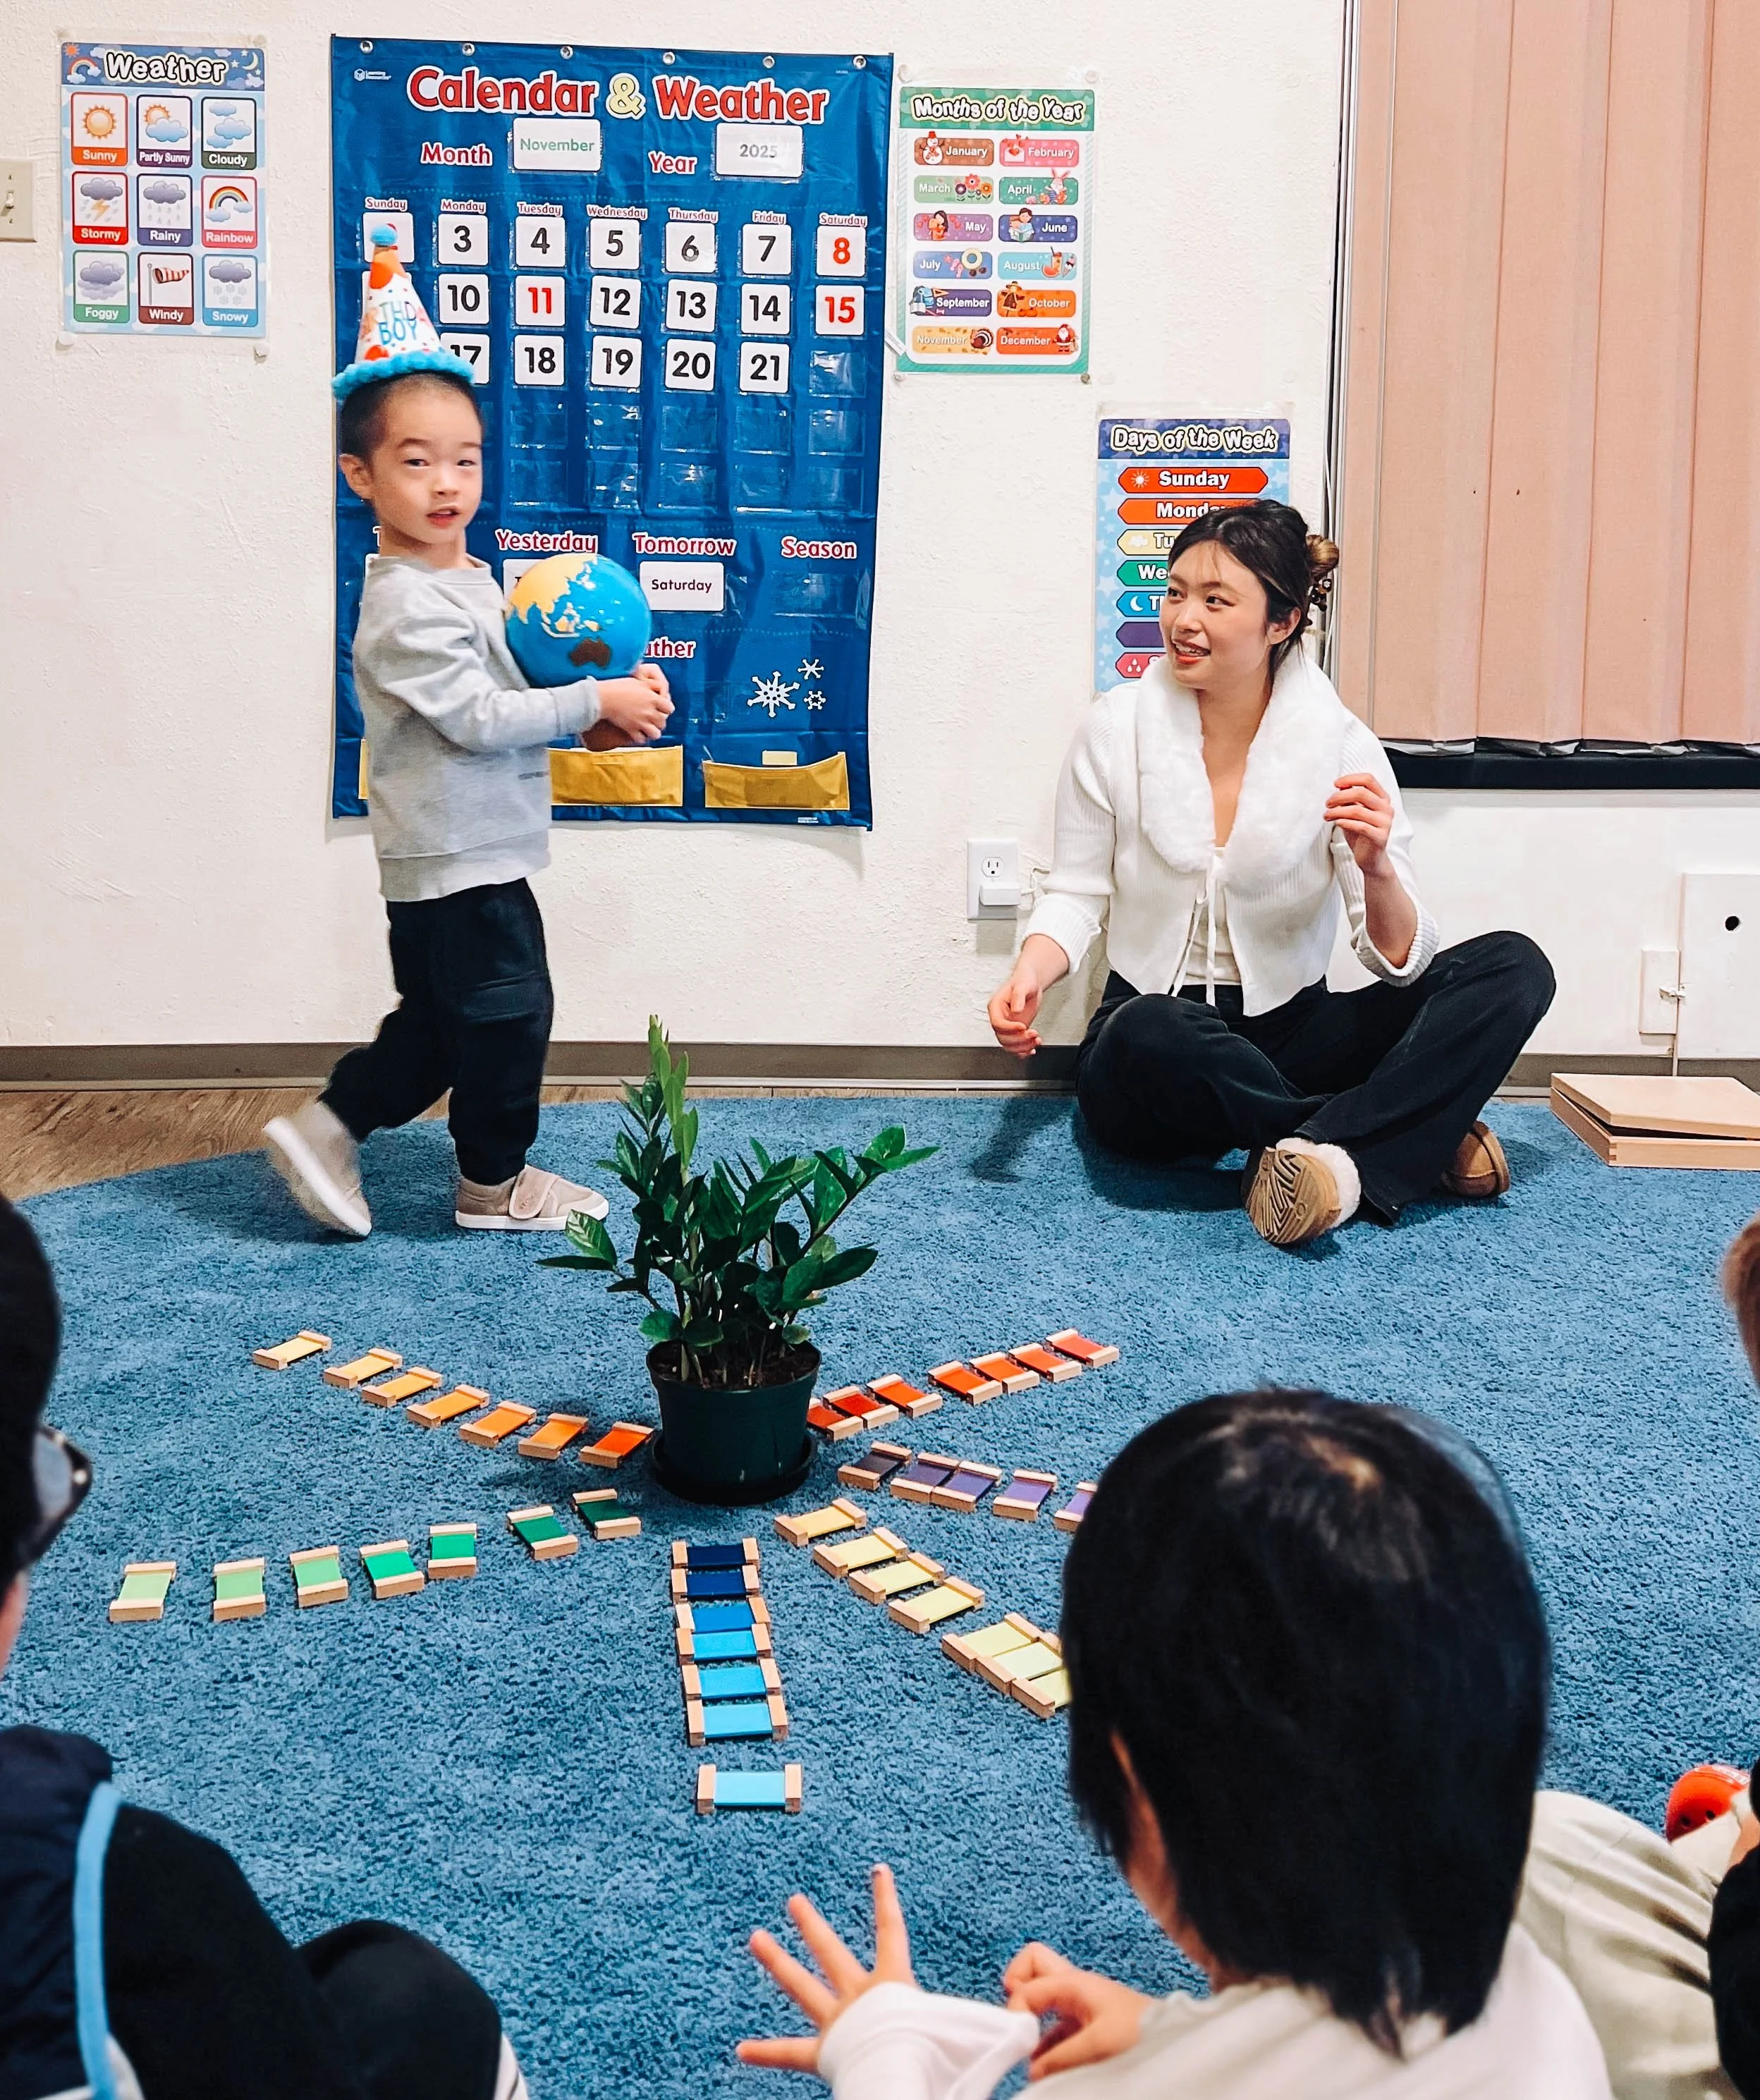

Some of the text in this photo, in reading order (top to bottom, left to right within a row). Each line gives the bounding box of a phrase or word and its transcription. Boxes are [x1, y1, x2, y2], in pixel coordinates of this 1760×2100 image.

[106, 51, 226, 83] Weather
[408, 68, 829, 124] Calendar & Weather
[913, 97, 1084, 122] Months of the Year
[520, 138, 594, 152] November
[739, 145, 778, 158] 2025
[82, 149, 117, 163] Sunny
[140, 152, 190, 165] Partly Sunny
[420, 142, 491, 165] Month
[946, 146, 987, 159] January
[1028, 147, 1074, 159] February
[209, 154, 248, 166] Cloudy
[649, 152, 697, 173] Year
[919, 183, 951, 193] March
[1008, 184, 1032, 196] April
[366, 198, 867, 227] Sunday Monday Tuesday Wednesday Thursday Friday Saturday
[965, 222, 986, 233] May
[1041, 223, 1068, 233] June
[81, 228, 121, 241] Stormy
[149, 230, 181, 243] Rainy
[206, 231, 254, 243] Rainbow
[453, 226, 850, 264] 3 4 5 6 7 8
[919, 260, 941, 271] July
[1003, 261, 1040, 272] August
[448, 285, 855, 323] 10 11 12 13 14 15
[936, 298, 989, 309] September
[1029, 298, 1070, 308] October
[85, 307, 119, 319] Foggy
[149, 309, 184, 322] Windy
[212, 311, 248, 324] Snowy
[917, 336, 966, 345] November
[1001, 336, 1051, 346] December
[525, 348, 556, 373] 18
[602, 348, 633, 375] 19
[672, 351, 710, 379] 20
[750, 355, 780, 381] 21
[1111, 427, 1278, 453] Days of the Week
[1159, 470, 1230, 489] Sunday
[1156, 502, 1226, 518] Mond
[496, 530, 857, 558] Yesterday Tomorrow Season
[652, 578, 711, 593] Saturday
